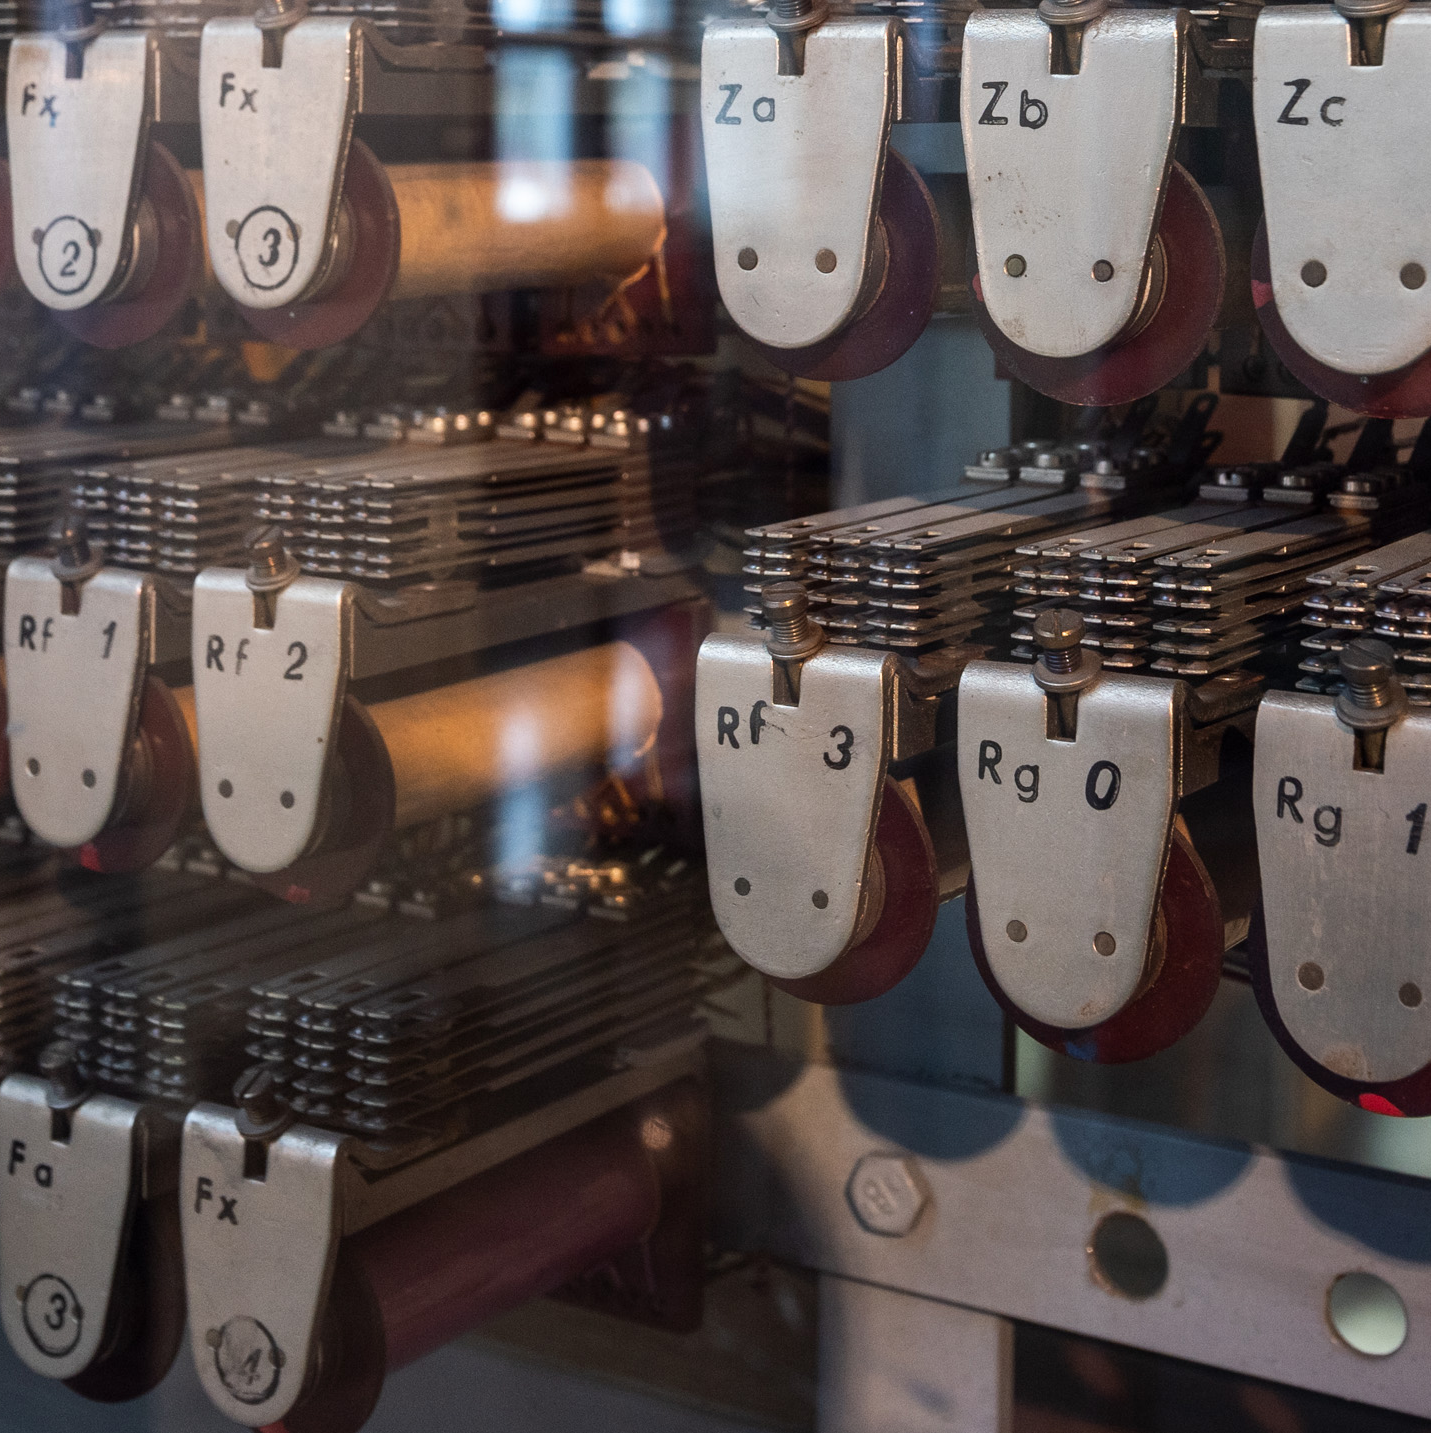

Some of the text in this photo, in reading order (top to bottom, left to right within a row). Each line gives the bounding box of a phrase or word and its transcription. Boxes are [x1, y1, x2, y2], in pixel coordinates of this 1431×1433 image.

[219, 72, 259, 114] Fx
[714, 83, 777, 126] Za
[978, 80, 1049, 130] Zb
[1277, 78, 1348, 128] Zc
[58, 239, 82, 278] 2
[257, 227, 283, 268] 3
[101, 619, 118, 660] 1
[283, 640, 309, 682] 2
[822, 724, 855, 771] 3
[978, 738, 1041, 803] Rg
[1276, 775, 1429, 856] Rg 1
[7, 1139, 55, 1189] Fa
[195, 1176, 240, 1226] Fx
[43, 1293, 68, 1332] 3
